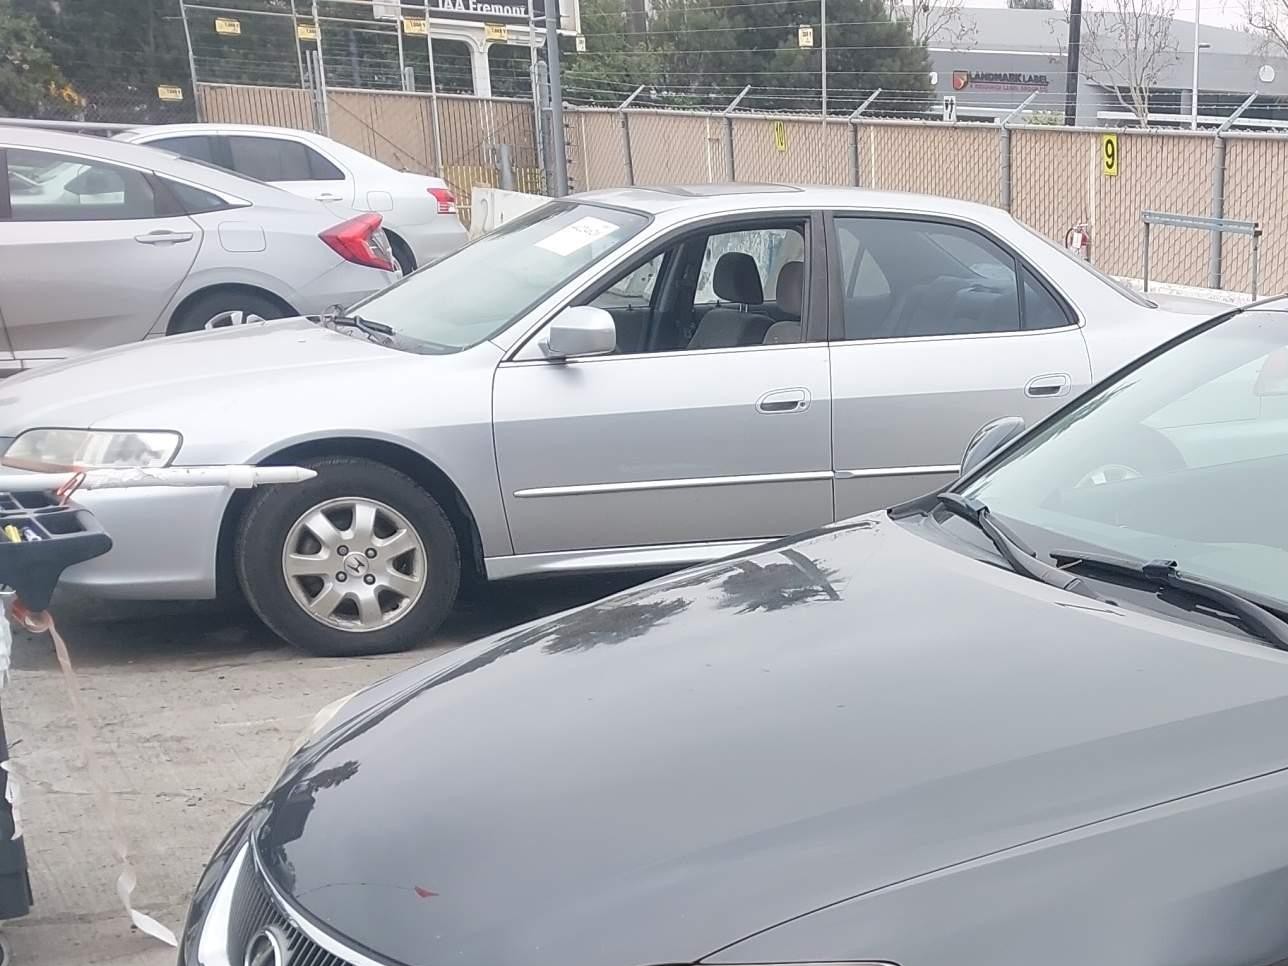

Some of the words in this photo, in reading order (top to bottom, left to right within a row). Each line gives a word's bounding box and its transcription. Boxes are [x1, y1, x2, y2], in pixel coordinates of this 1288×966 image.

[969, 71, 1021, 82] LANDMARK
[1022, 73, 1048, 83] LABEL
[1105, 139, 1115, 170] 9
